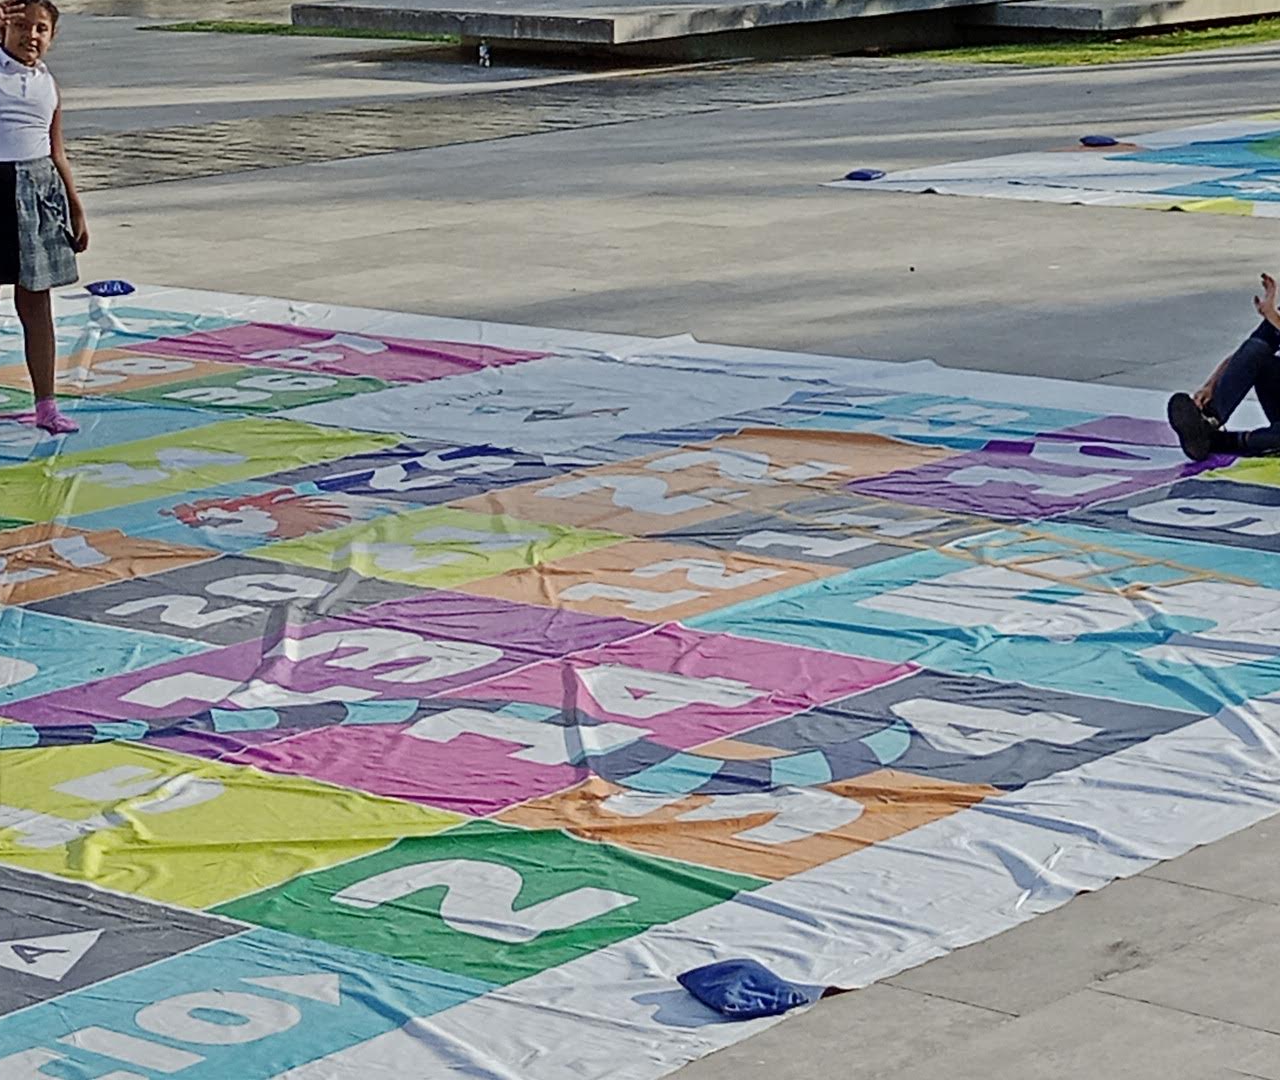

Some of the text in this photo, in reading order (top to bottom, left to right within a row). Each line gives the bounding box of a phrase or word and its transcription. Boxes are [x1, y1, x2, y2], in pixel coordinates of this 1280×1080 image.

[240, 333, 390, 366] 37
[161, 375, 339, 406] 36
[57, 447, 247, 488] 34
[367, 447, 515, 493] 25
[534, 447, 851, 516] 22
[947, 441, 1194, 498] 10
[329, 525, 553, 573] 21
[736, 511, 952, 558] 11
[104, 573, 336, 630] 20
[558, 558, 787, 613] 12
[118, 628, 504, 710] 13
[407, 663, 772, 766] 14
[889, 697, 1109, 755] 4
[599, 785, 865, 845] 3
[328, 858, 639, 944] 2
